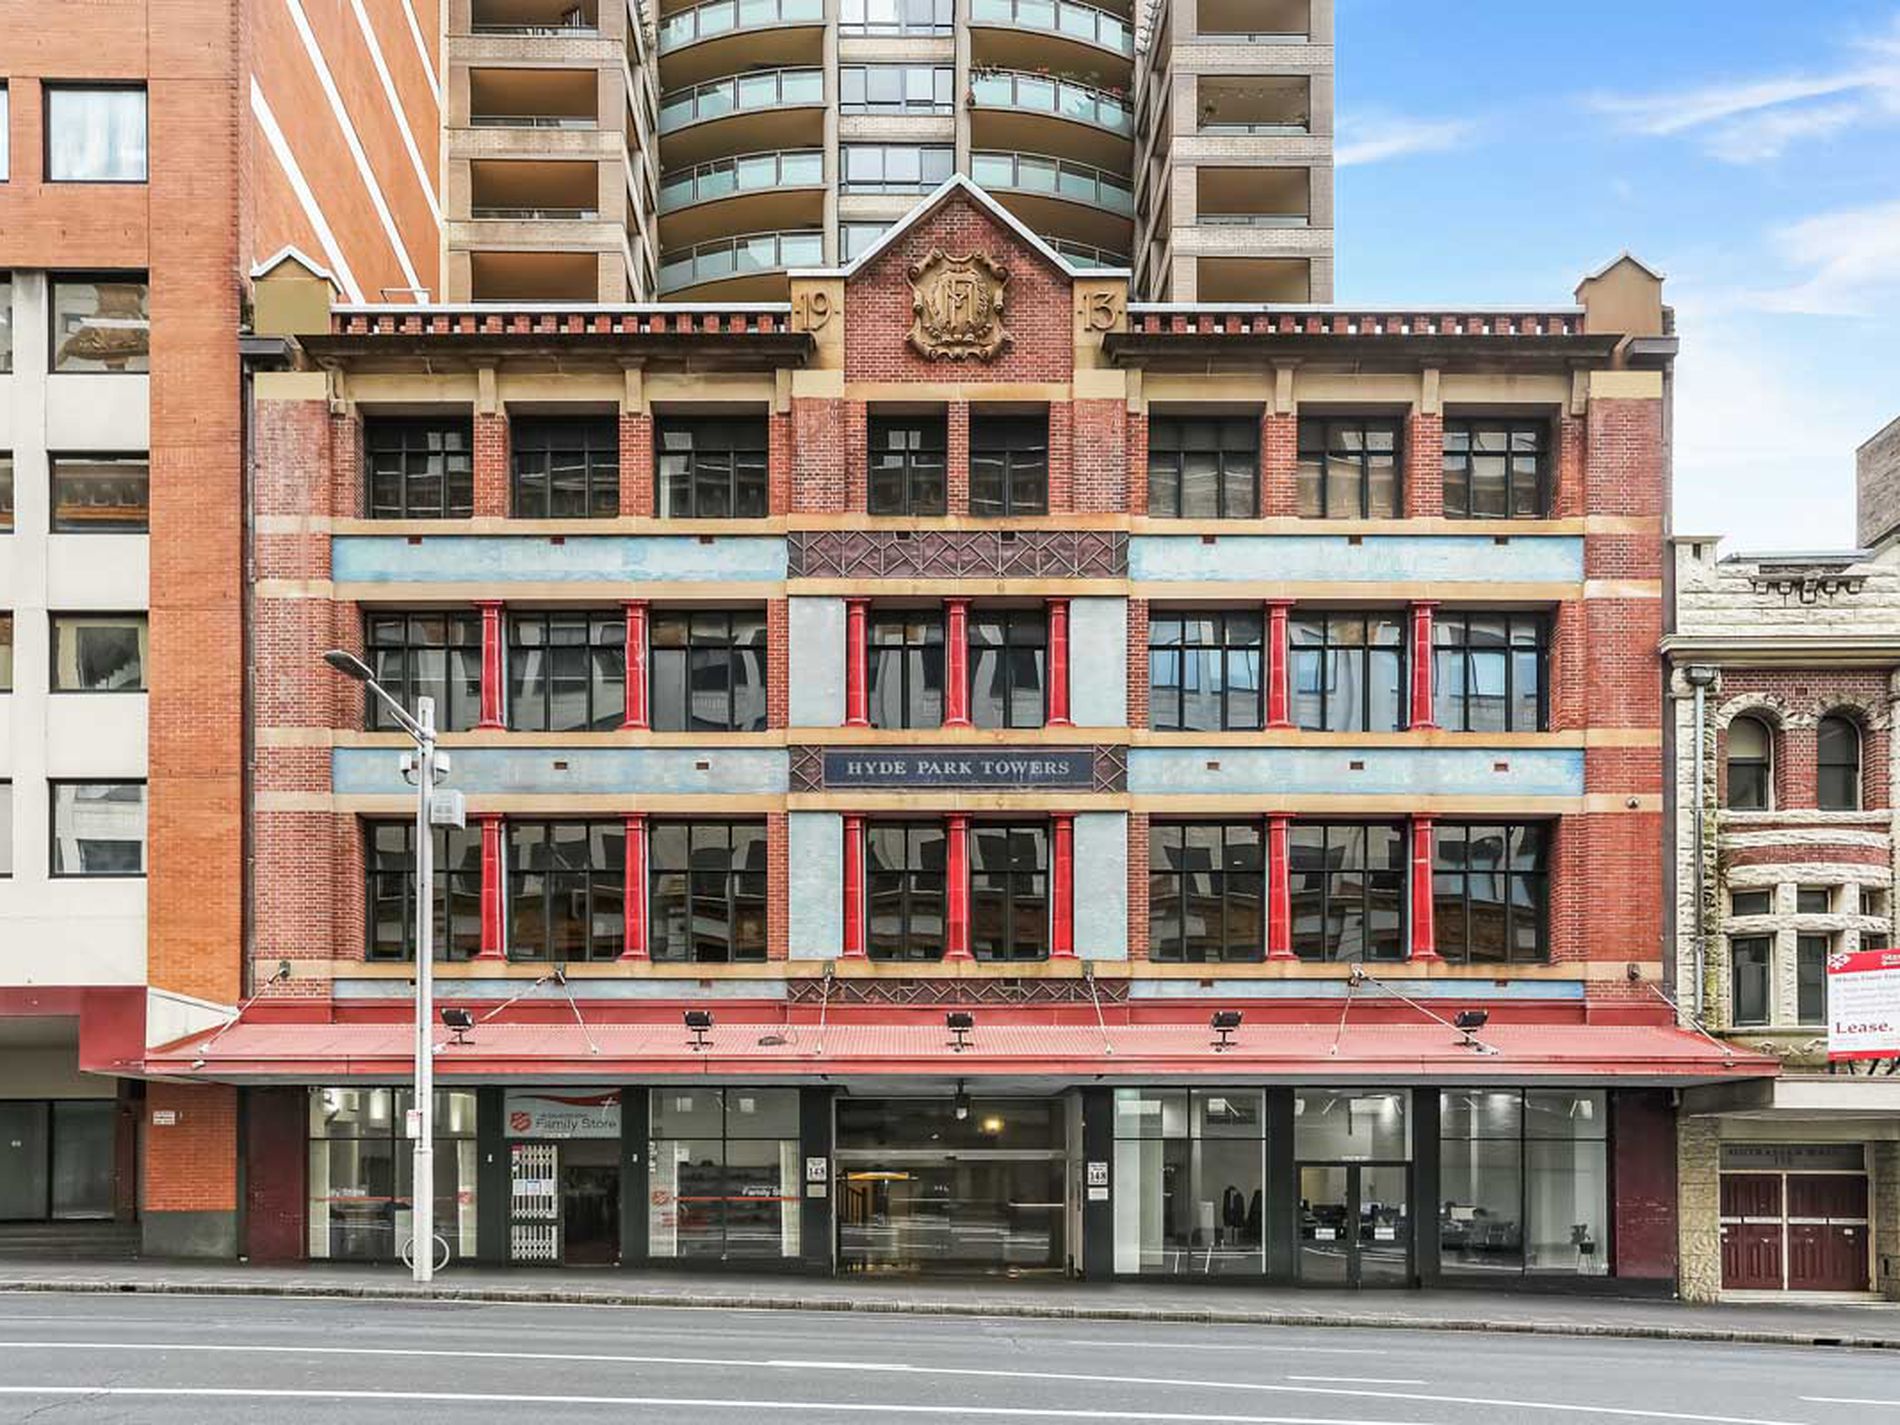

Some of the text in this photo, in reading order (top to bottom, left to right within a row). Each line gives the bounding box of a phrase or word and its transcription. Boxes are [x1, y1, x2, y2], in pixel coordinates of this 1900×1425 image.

[800, 292, 832, 331] 19
[1082, 291, 1117, 332] 13
[847, 761, 1070, 775] HYDE PARK TOWERS
[1835, 1021, 1894, 1035] Lease.
[536, 1117, 617, 1130] Family Store
